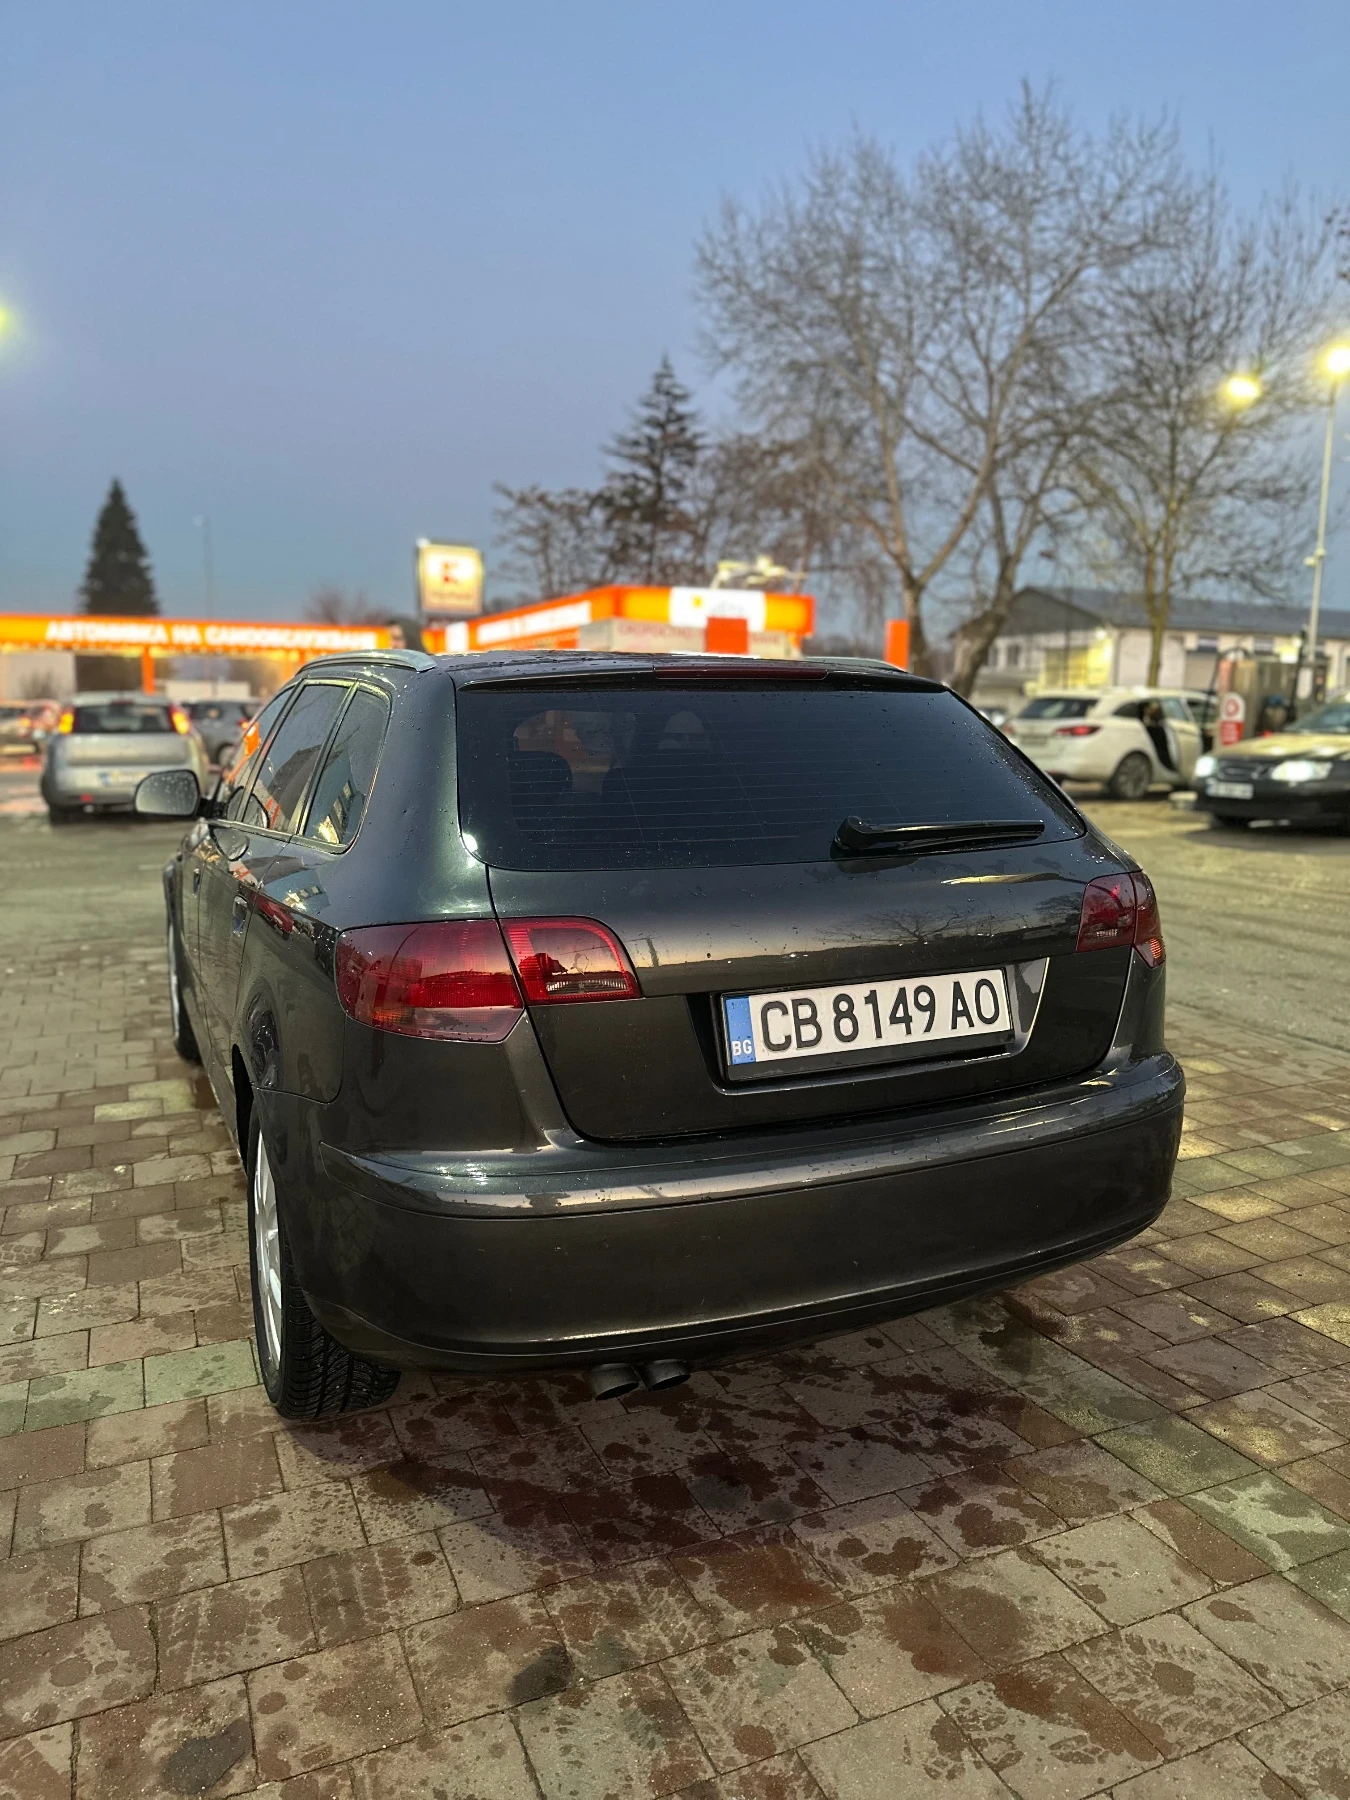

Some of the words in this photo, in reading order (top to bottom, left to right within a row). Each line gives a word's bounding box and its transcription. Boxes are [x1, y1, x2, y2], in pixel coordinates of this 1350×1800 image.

[760, 997, 822, 1052] CB
[832, 985, 936, 1042] 8149
[950, 978, 1000, 1030] AO
[732, 1039, 753, 1056] BG
